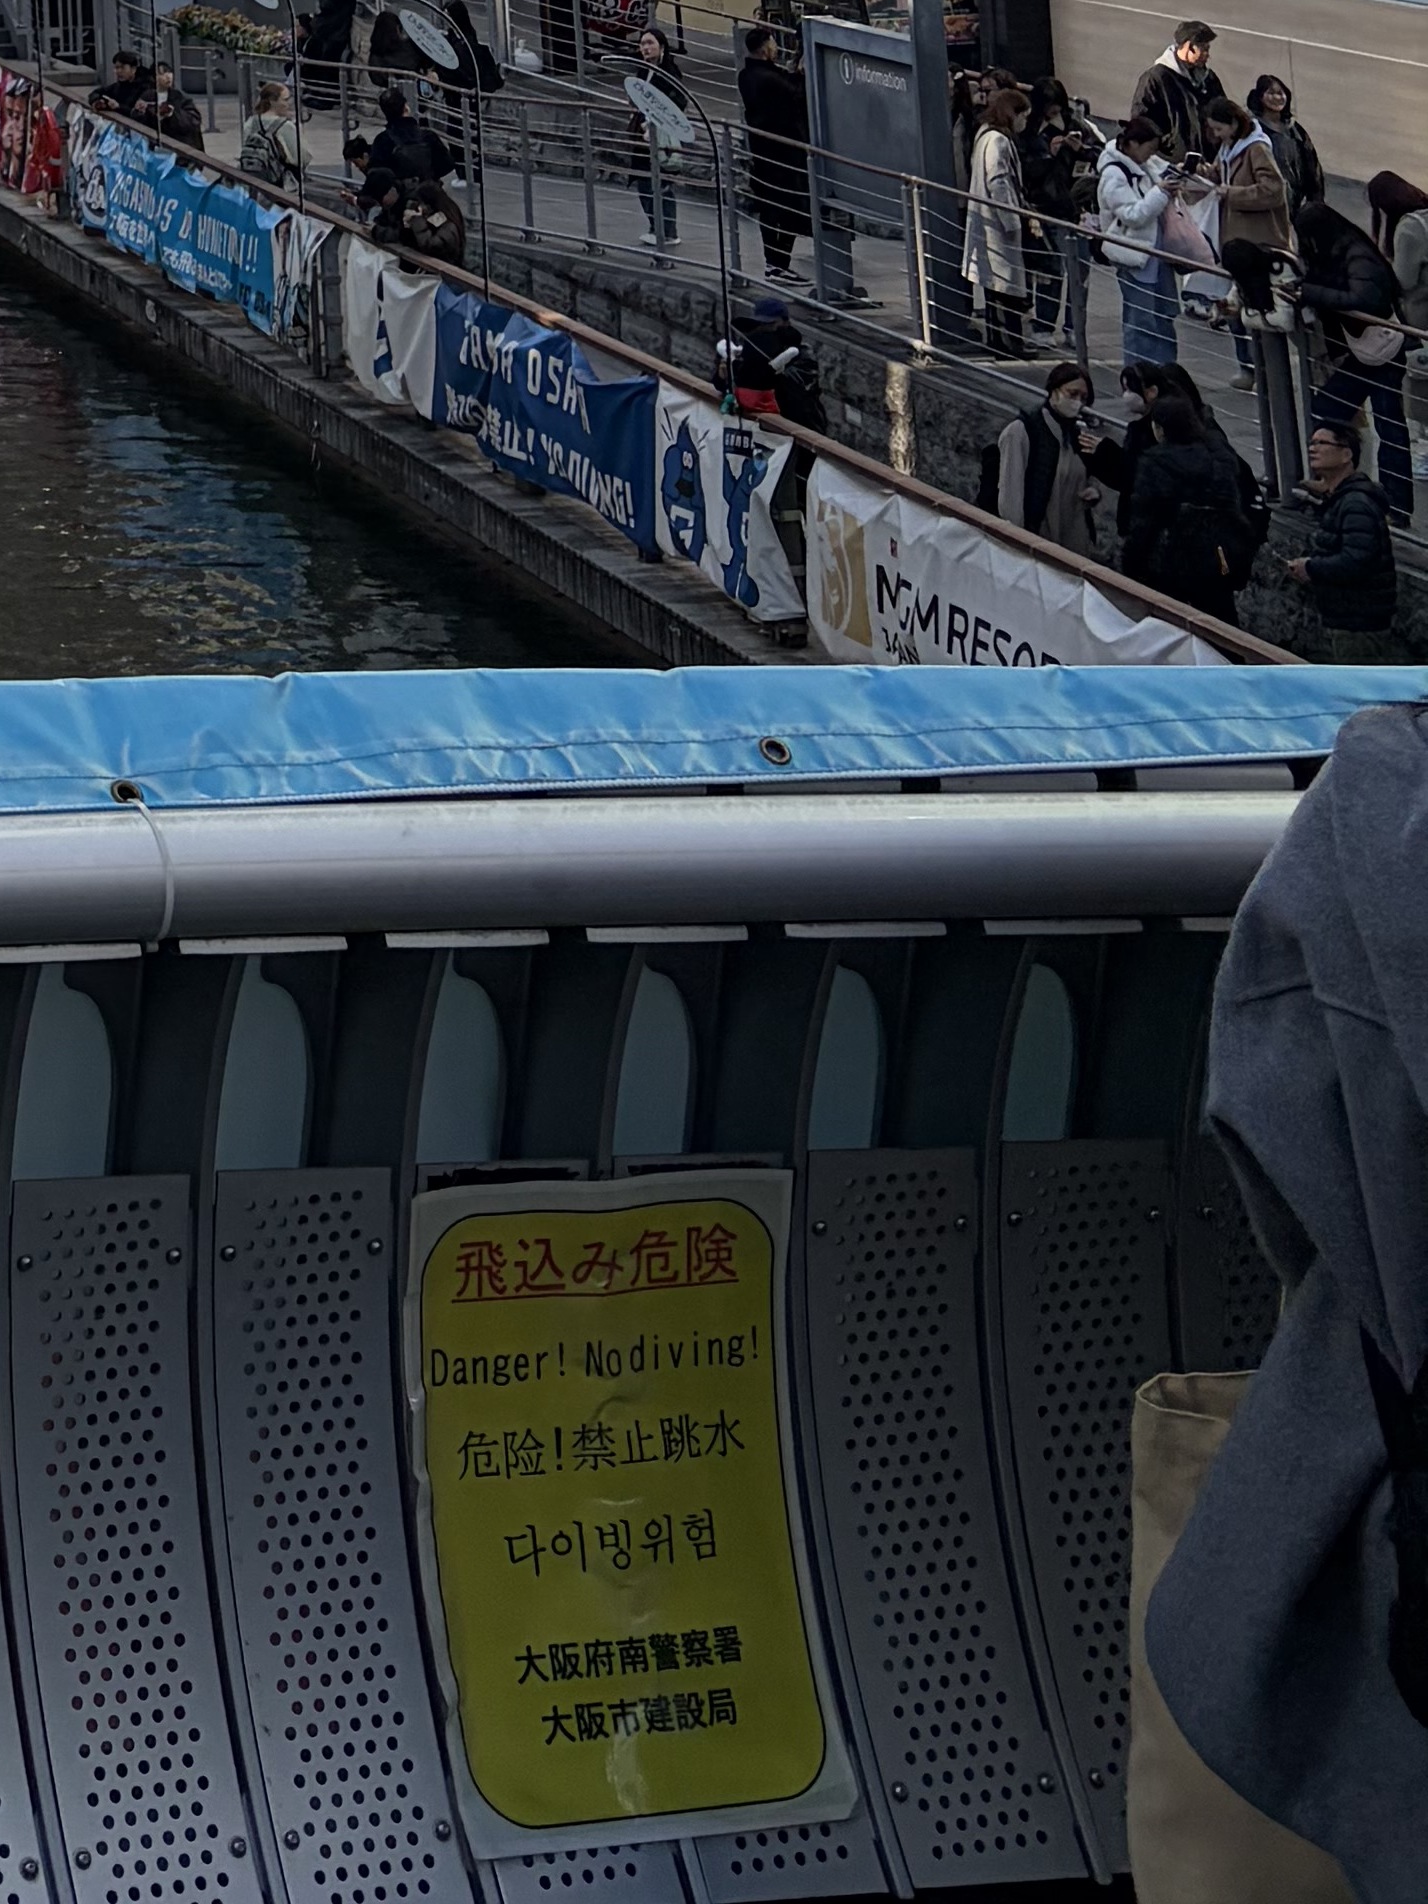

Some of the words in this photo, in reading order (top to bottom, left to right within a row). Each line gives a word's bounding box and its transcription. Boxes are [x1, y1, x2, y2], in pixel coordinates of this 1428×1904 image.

[855, 63, 907, 91] information
[454, 1222, 739, 1299] 飛込み危険
[430, 1344, 567, 1389] Danger!
[457, 1409, 745, 1484] 危险!禁止跳水
[503, 1506, 719, 1579] 다이빙위험
[515, 1625, 744, 1687] 大阪府南警察署
[541, 1687, 738, 1747] 大阪市建設局
